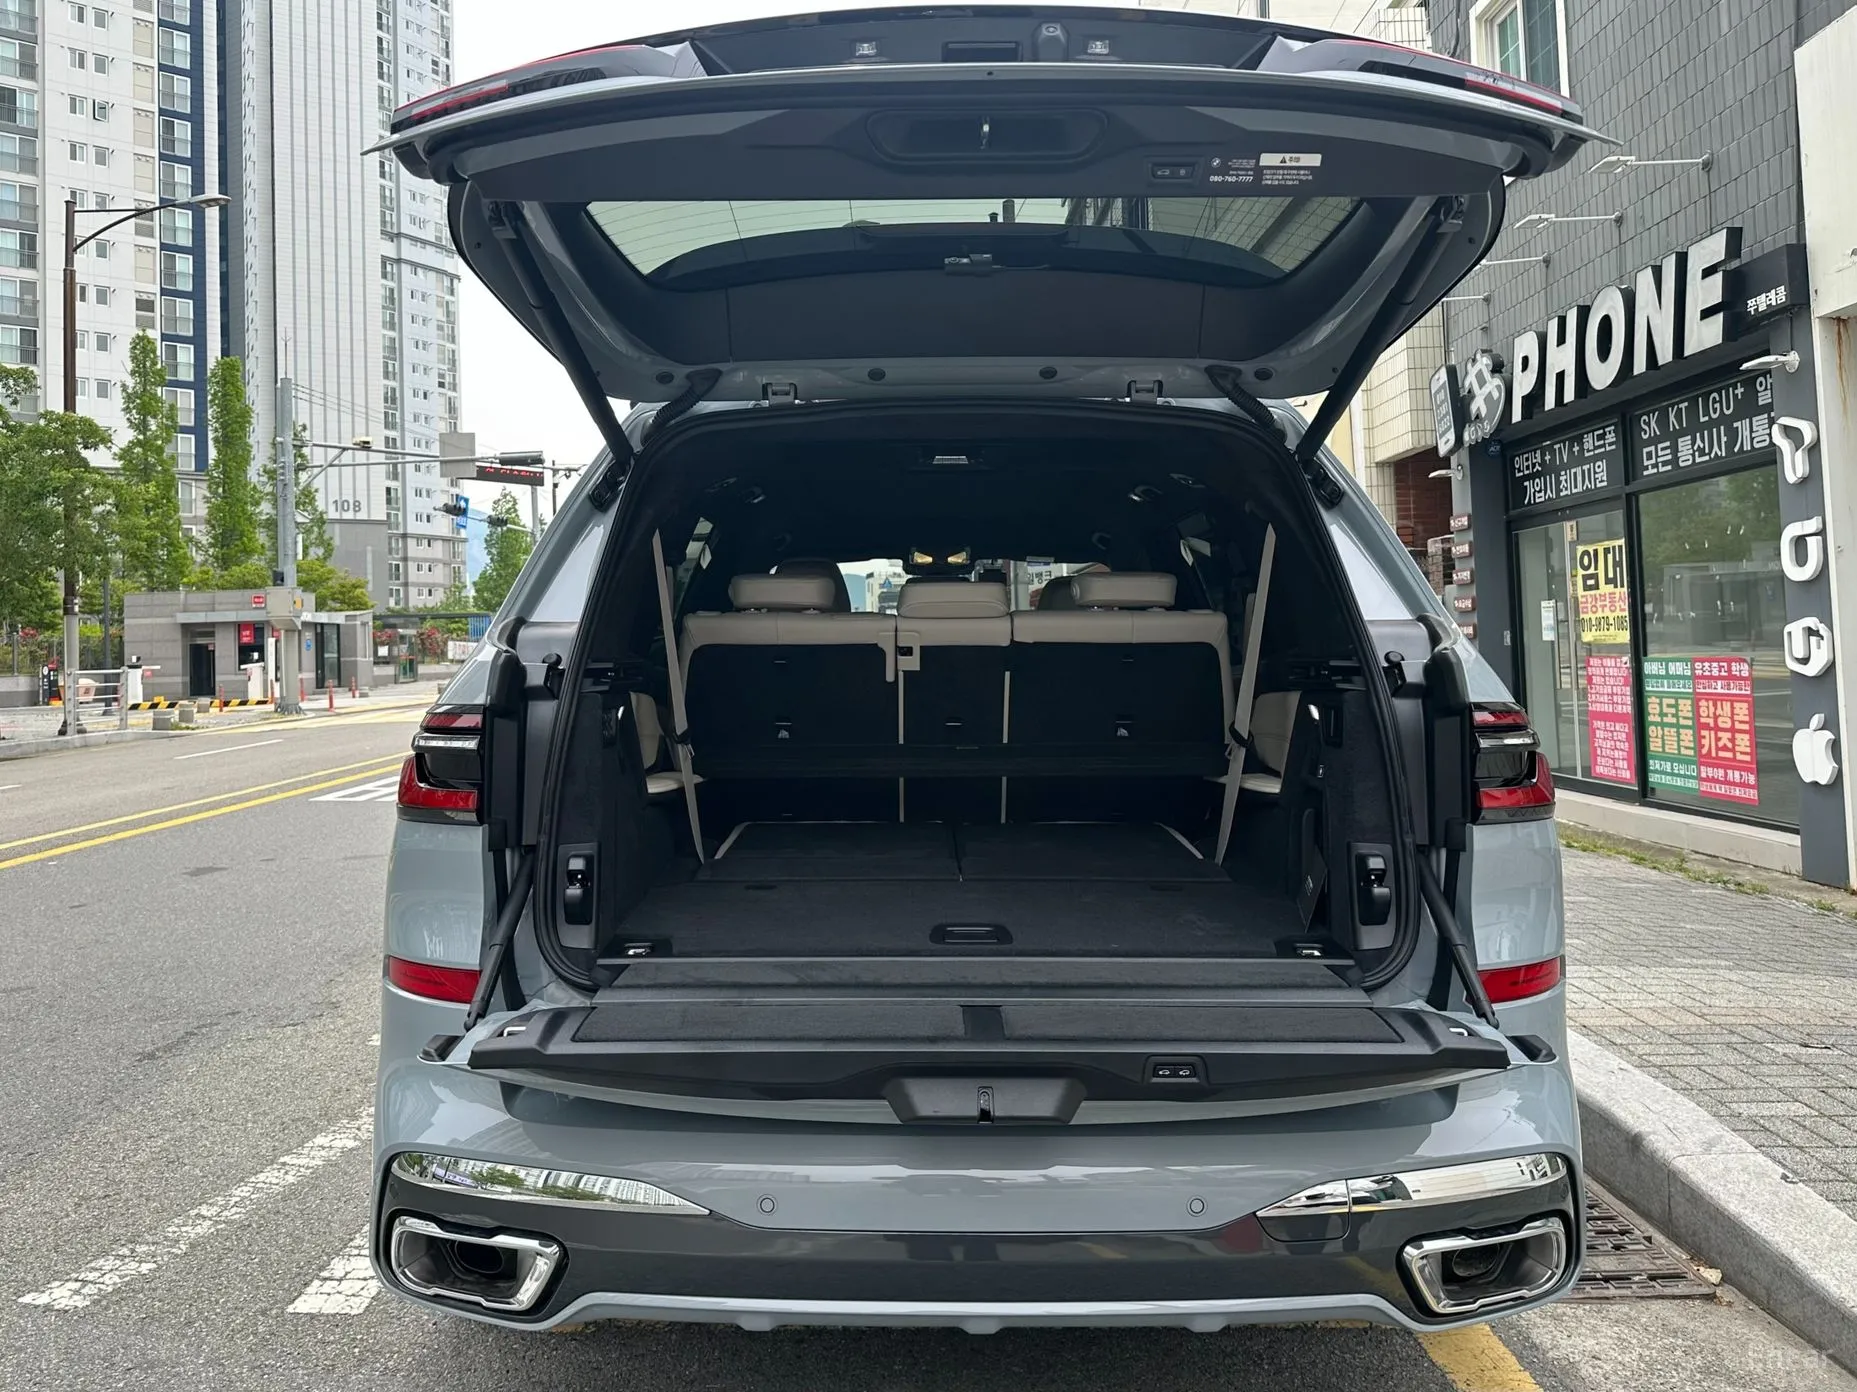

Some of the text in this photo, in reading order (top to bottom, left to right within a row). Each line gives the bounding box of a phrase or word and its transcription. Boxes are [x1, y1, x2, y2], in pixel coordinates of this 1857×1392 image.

[1209, 175, 1253, 183] 080-760-7777
[1511, 227, 1738, 424] PHONE
[1640, 411, 1660, 439] SK
[1668, 402, 1688, 431] KT
[1698, 382, 1744, 423] LGU+
[1514, 449, 1542, 477] 인터넷
[1553, 441, 1569, 465] TV
[1583, 425, 1617, 457] 핸드폰
[1642, 411, 1774, 476] 모든 통신사 개통
[1523, 459, 1608, 505] 가입시 최대지원
[332, 499, 362, 513] 108
[1578, 545, 1625, 592] 임대
[1580, 592, 1628, 615] 금강부동산
[1694, 661, 1749, 677] 유초중고 학생
[1647, 696, 1693, 726] 효도폰
[1699, 699, 1751, 730] 학생폰
[1648, 725, 1694, 755] 알뜰폰
[1701, 729, 1752, 761] 키즈폰
